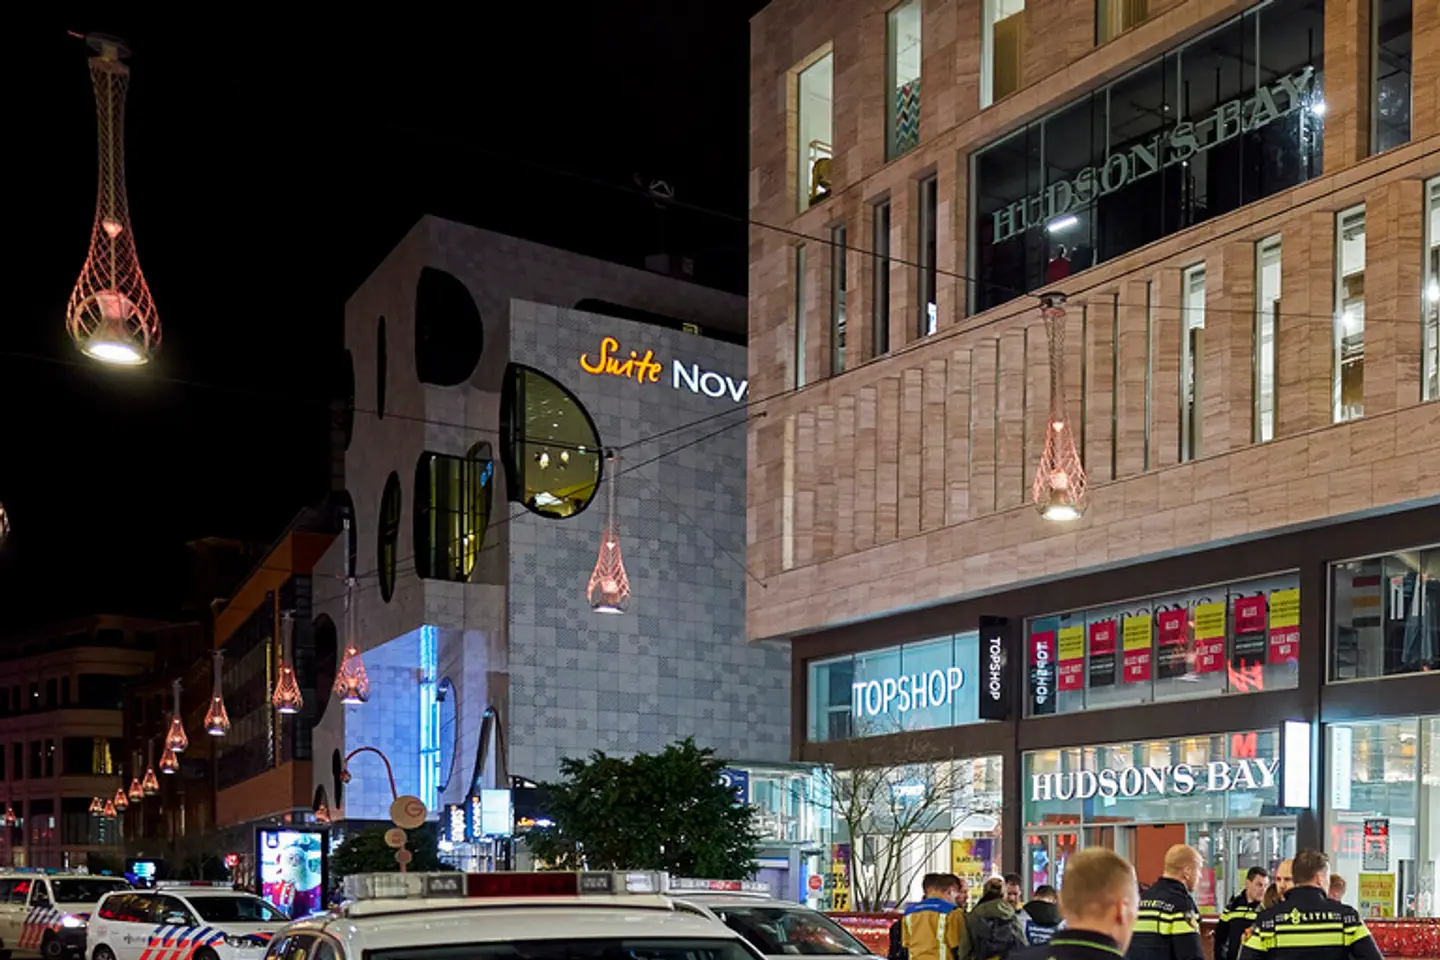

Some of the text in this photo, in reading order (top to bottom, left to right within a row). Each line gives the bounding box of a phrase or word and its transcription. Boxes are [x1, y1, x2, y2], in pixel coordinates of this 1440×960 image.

[992, 65, 1316, 246] HUDSON'S BAY
[579, 336, 749, 402] Suite NOV
[852, 667, 964, 716] TOPSHOP
[989, 637, 1001, 700] TOPSHOP
[1031, 757, 1280, 802] HUDSON'S BAY
